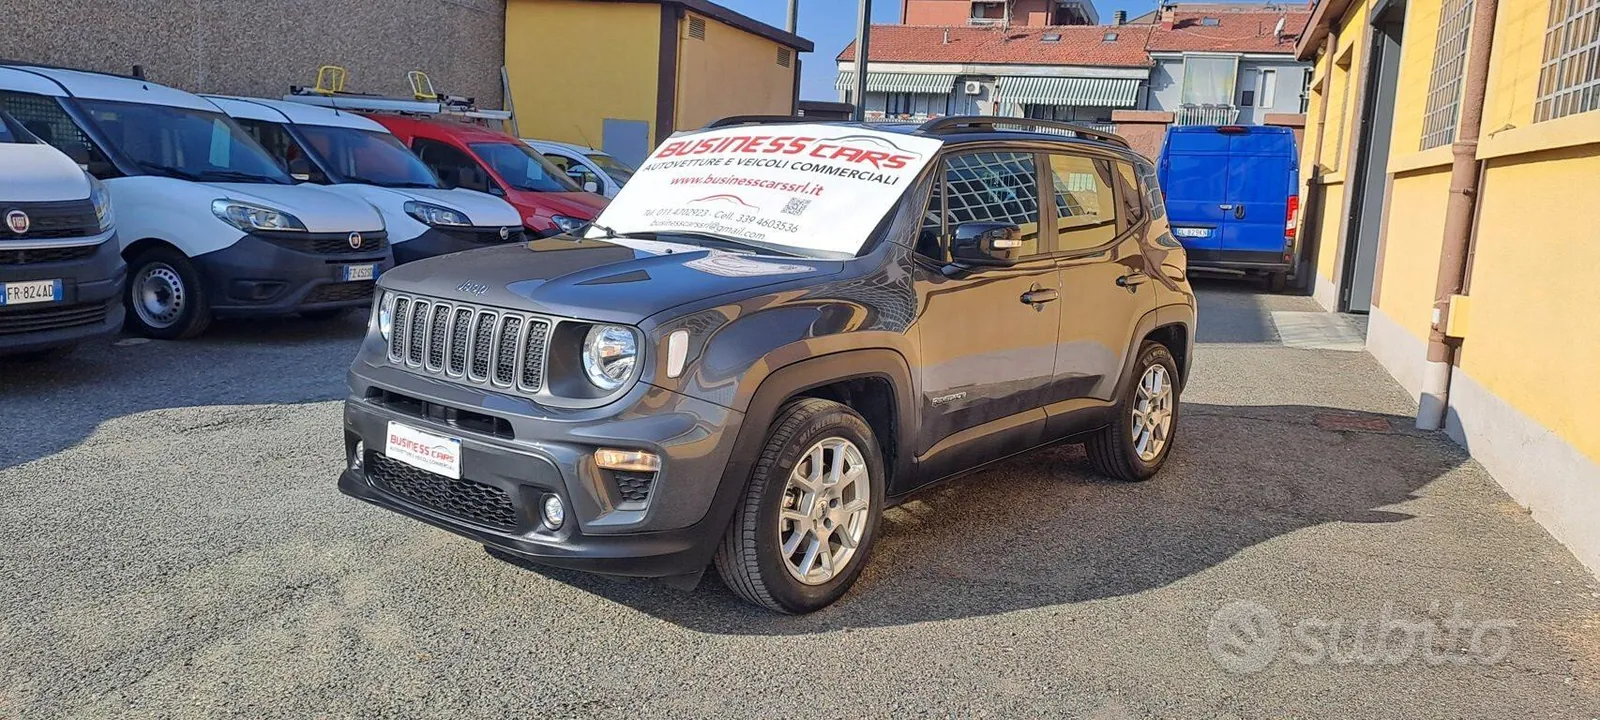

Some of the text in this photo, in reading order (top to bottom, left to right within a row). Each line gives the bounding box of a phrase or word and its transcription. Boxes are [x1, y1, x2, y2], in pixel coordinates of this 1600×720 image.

[655, 135, 916, 170] BUSINESS CARS
[642, 157, 900, 186] AUTOVETTURE E VEICOLI COMMERCIALI
[670, 174, 824, 197] www.businesscarssrl.it
[714, 210, 734, 221] Cell.
[735, 214, 756, 224] 339
[756, 217, 800, 234] 4603536
[389, 434, 430, 457] BUSINESS
[431, 449, 456, 464] CARS
